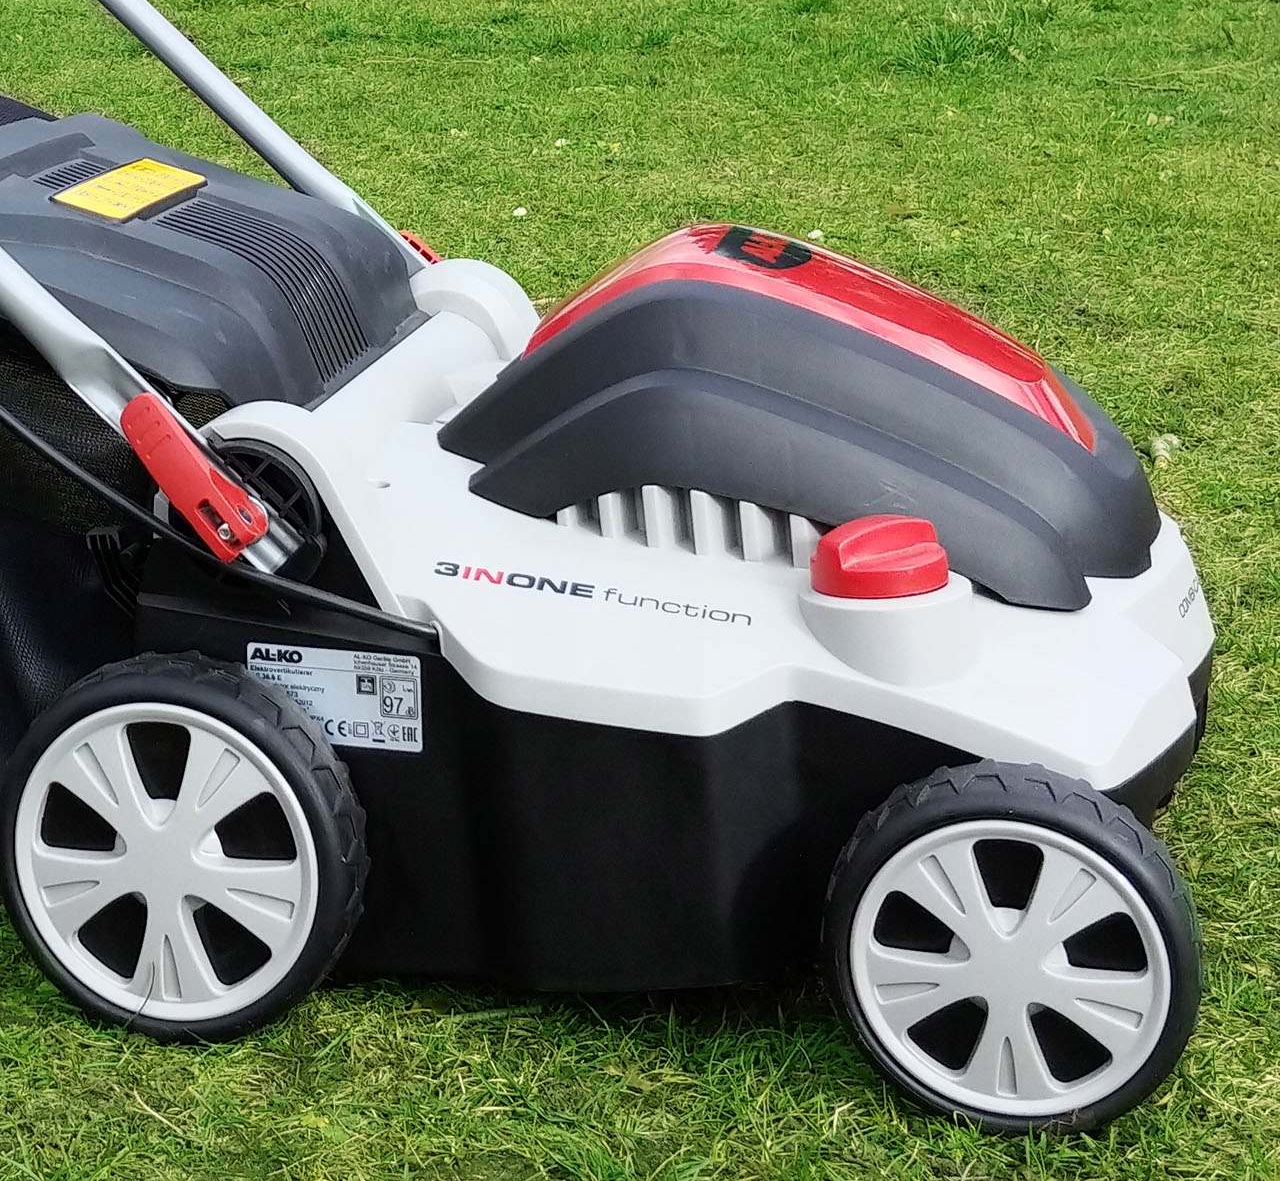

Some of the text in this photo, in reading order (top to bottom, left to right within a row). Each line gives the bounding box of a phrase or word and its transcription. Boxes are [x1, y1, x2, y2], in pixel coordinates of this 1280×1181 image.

[433, 561, 752, 627] 3INONE function
[250, 647, 303, 664] AL-KO
[250, 665, 313, 676] Elektrovertikutierer
[290, 684, 325, 694] elektryczny
[383, 695, 404, 714] 97
[324, 719, 347, 738] CE
